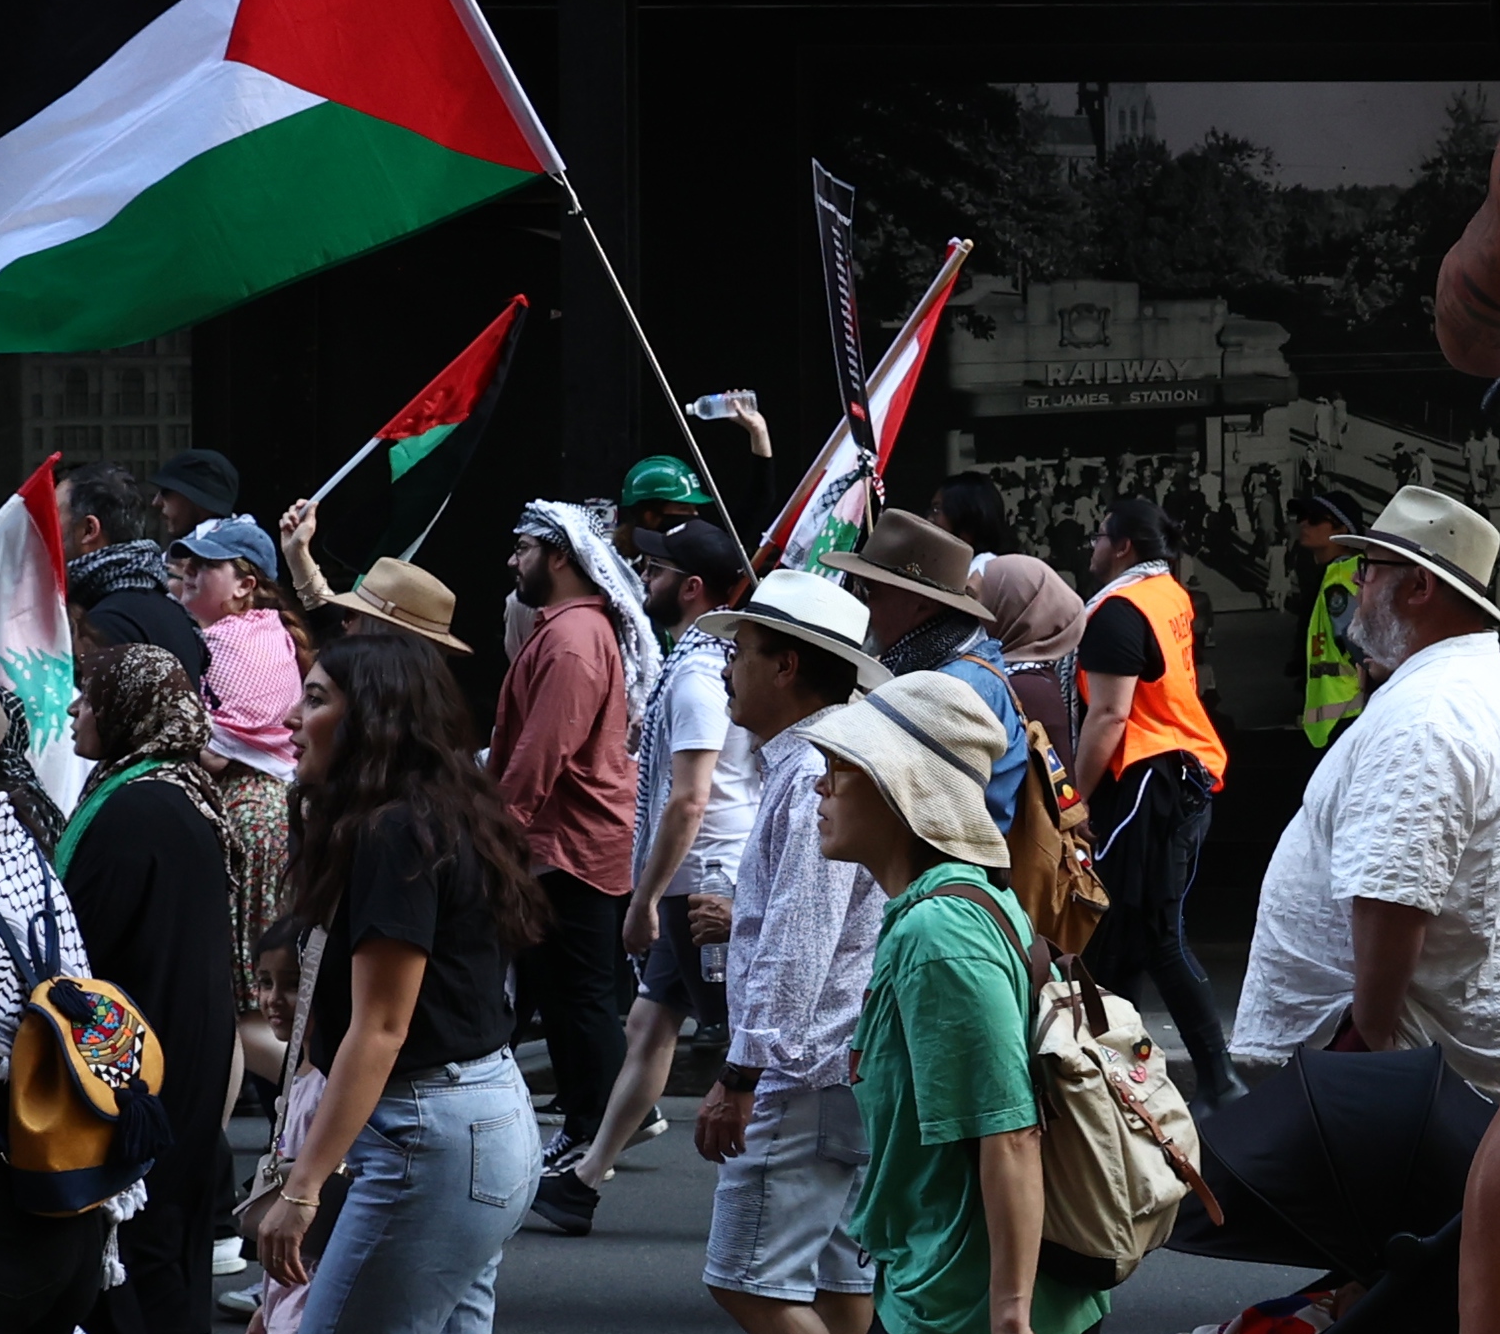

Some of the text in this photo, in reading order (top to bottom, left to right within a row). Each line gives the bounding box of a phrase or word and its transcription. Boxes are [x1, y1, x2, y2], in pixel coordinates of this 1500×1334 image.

[1045, 358, 1191, 386] RAILWAY
[1053, 392, 1111, 407] JAMES
[1129, 389, 1199, 404] STATION
